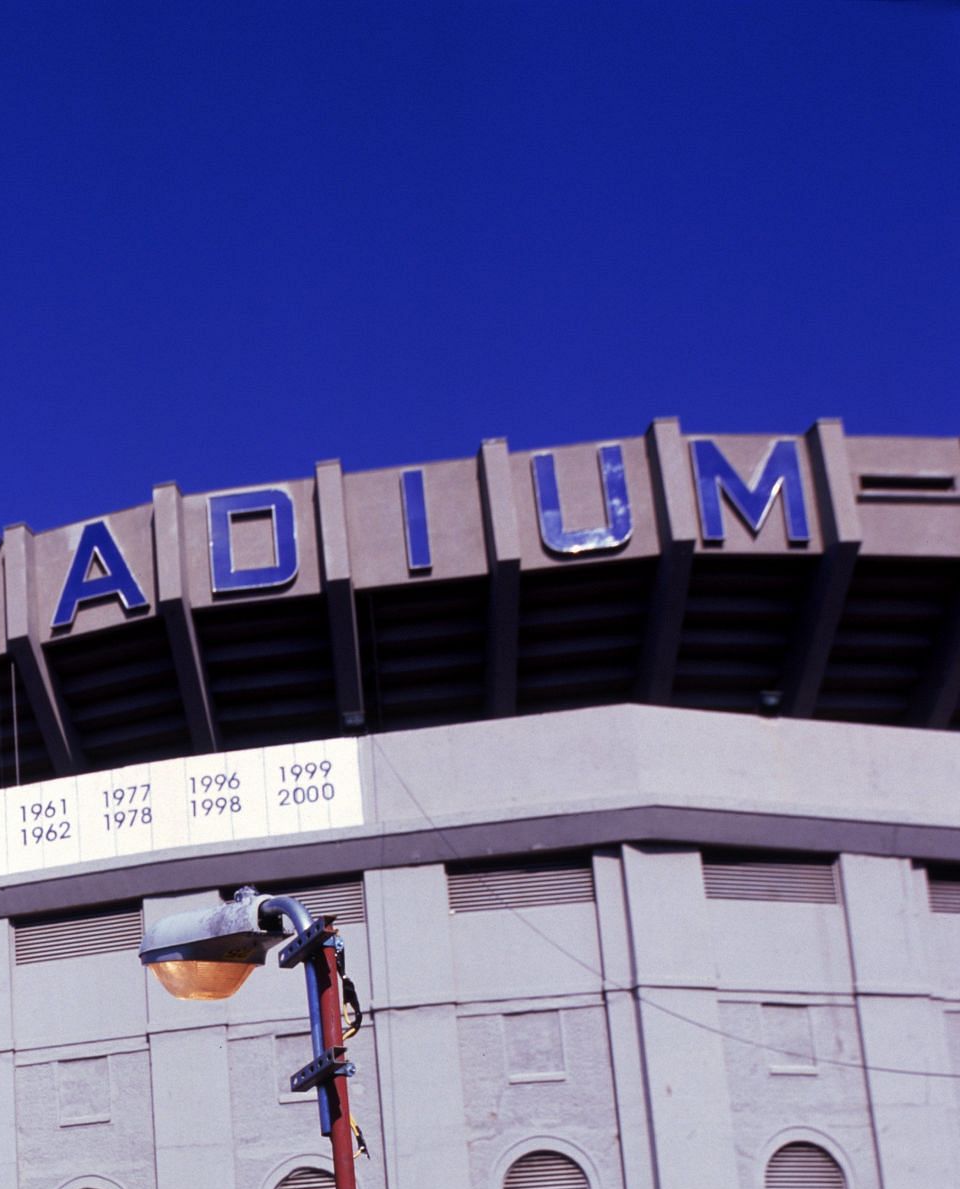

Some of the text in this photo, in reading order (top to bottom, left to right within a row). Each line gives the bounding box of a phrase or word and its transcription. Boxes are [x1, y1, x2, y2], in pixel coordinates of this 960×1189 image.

[19, 798, 68, 823] 1961
[102, 783, 152, 808] 1977
[189, 771, 241, 795] 1996
[279, 759, 333, 783] 1999
[21, 821, 72, 846] 1962
[103, 807, 153, 832] 1978
[190, 795, 242, 818] 1998
[277, 782, 335, 807] 2000
